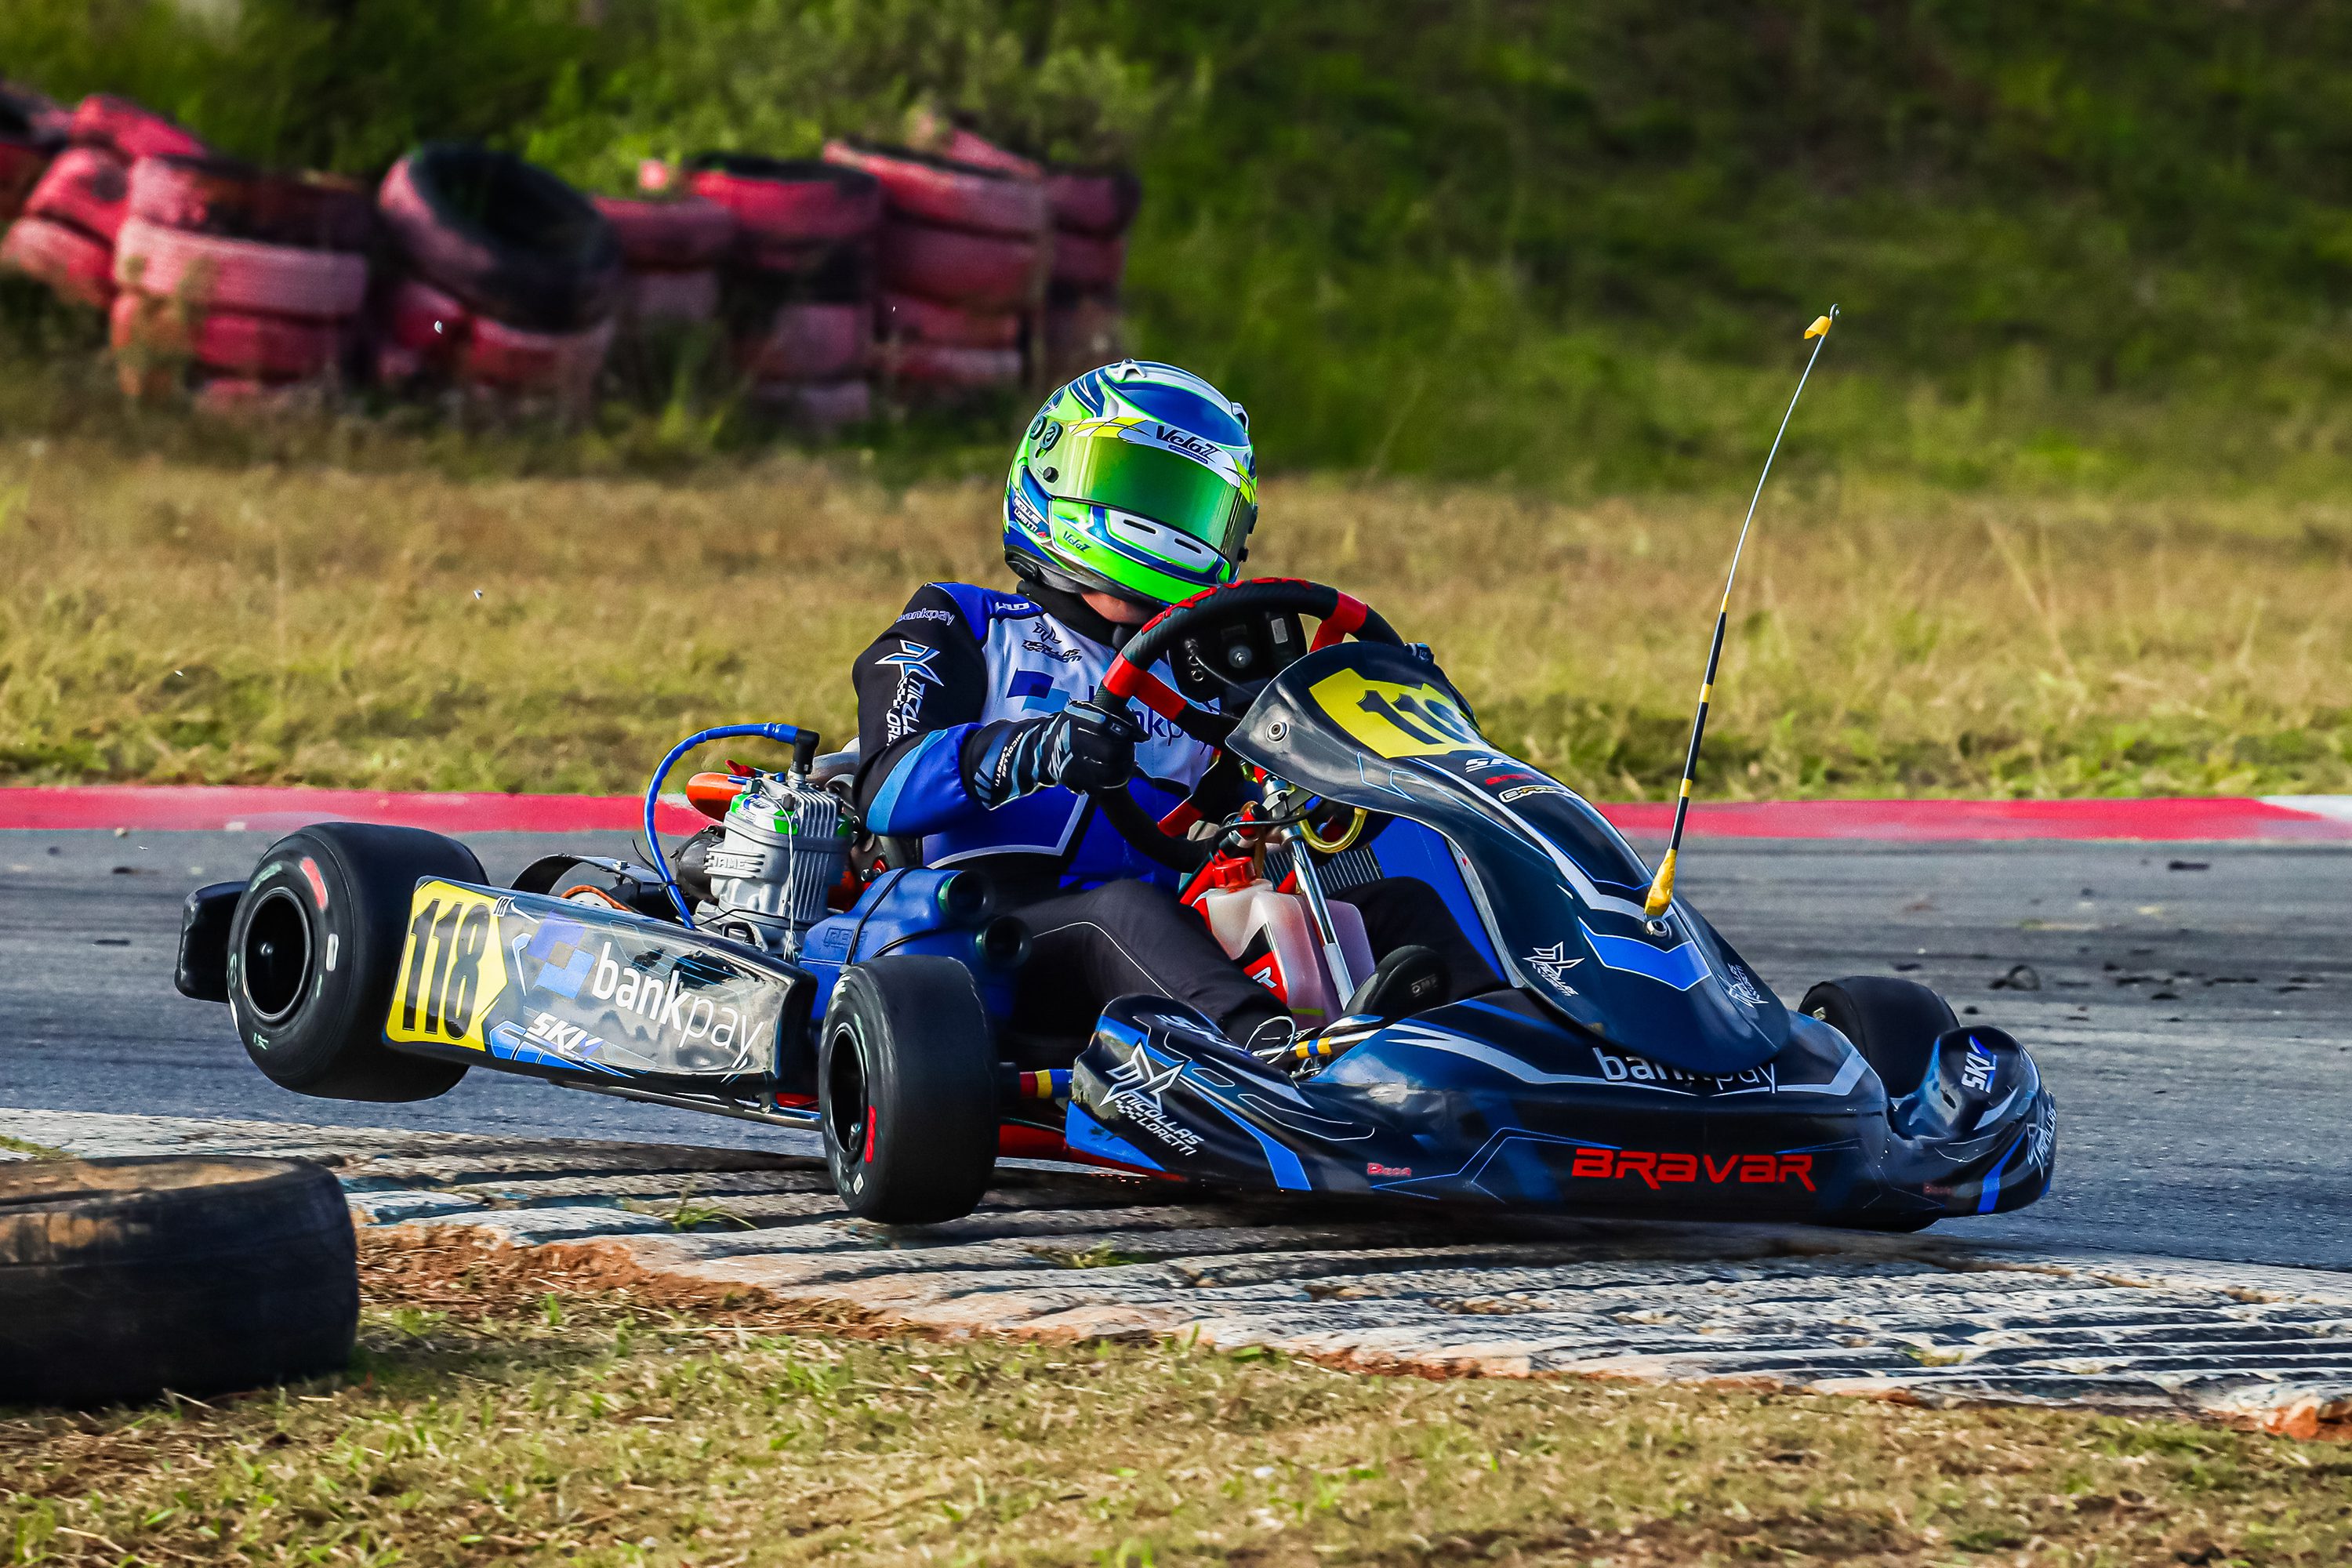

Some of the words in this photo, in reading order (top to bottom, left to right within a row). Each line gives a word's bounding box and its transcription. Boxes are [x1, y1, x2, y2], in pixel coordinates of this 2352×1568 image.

[402, 898, 492, 1040] 118
[592, 942, 765, 1069] bankpay
[1120, 1092, 1205, 1146] NICOLLAS
[1137, 1117, 1197, 1156] LORETTI
